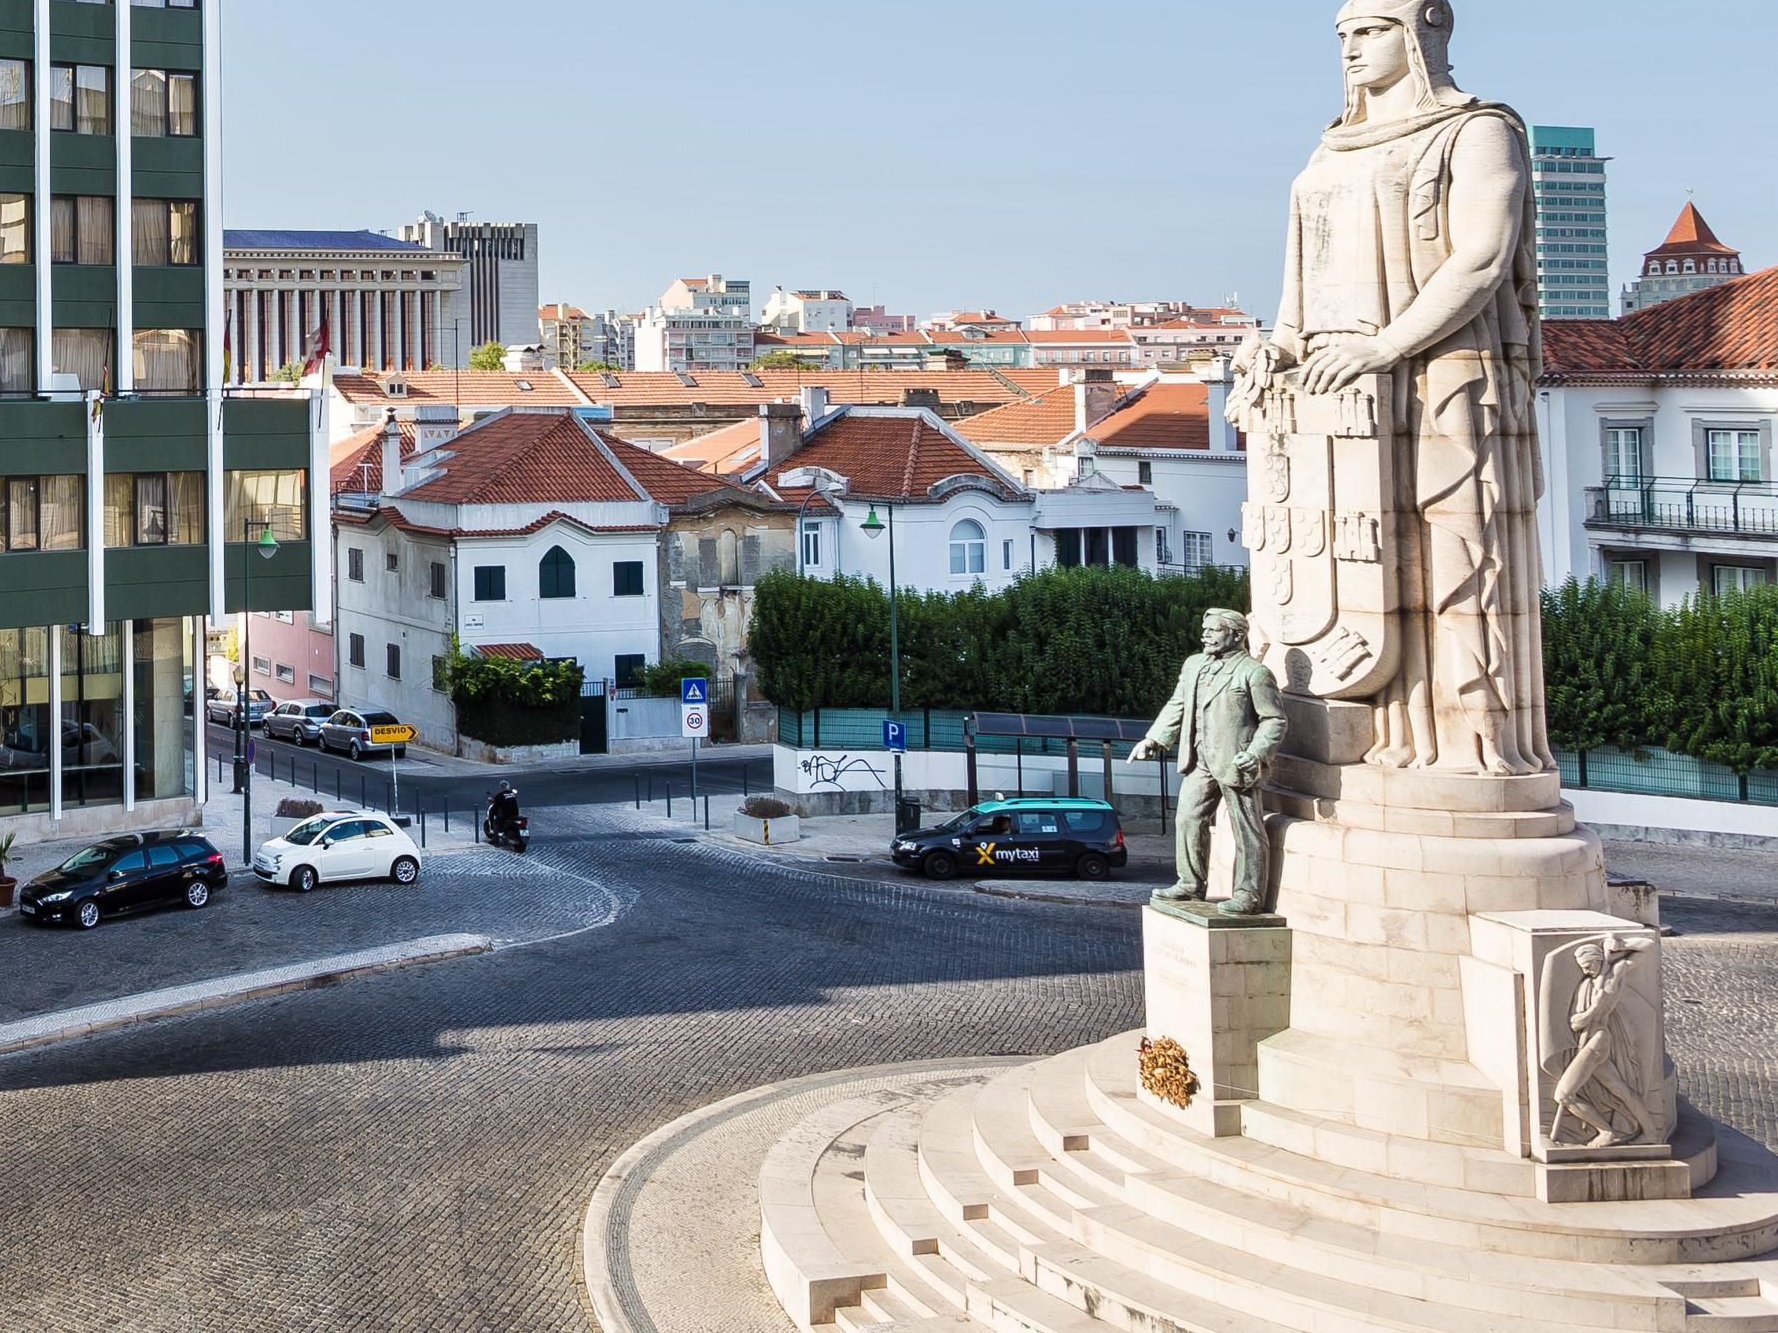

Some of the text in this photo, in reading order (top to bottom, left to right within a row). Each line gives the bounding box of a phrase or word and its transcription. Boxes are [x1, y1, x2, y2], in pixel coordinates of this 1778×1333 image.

[689, 717, 701, 725] 30
[374, 726, 407, 735] DESVIO
[889, 723, 899, 741] P
[995, 846, 1040, 862] mytaxi
